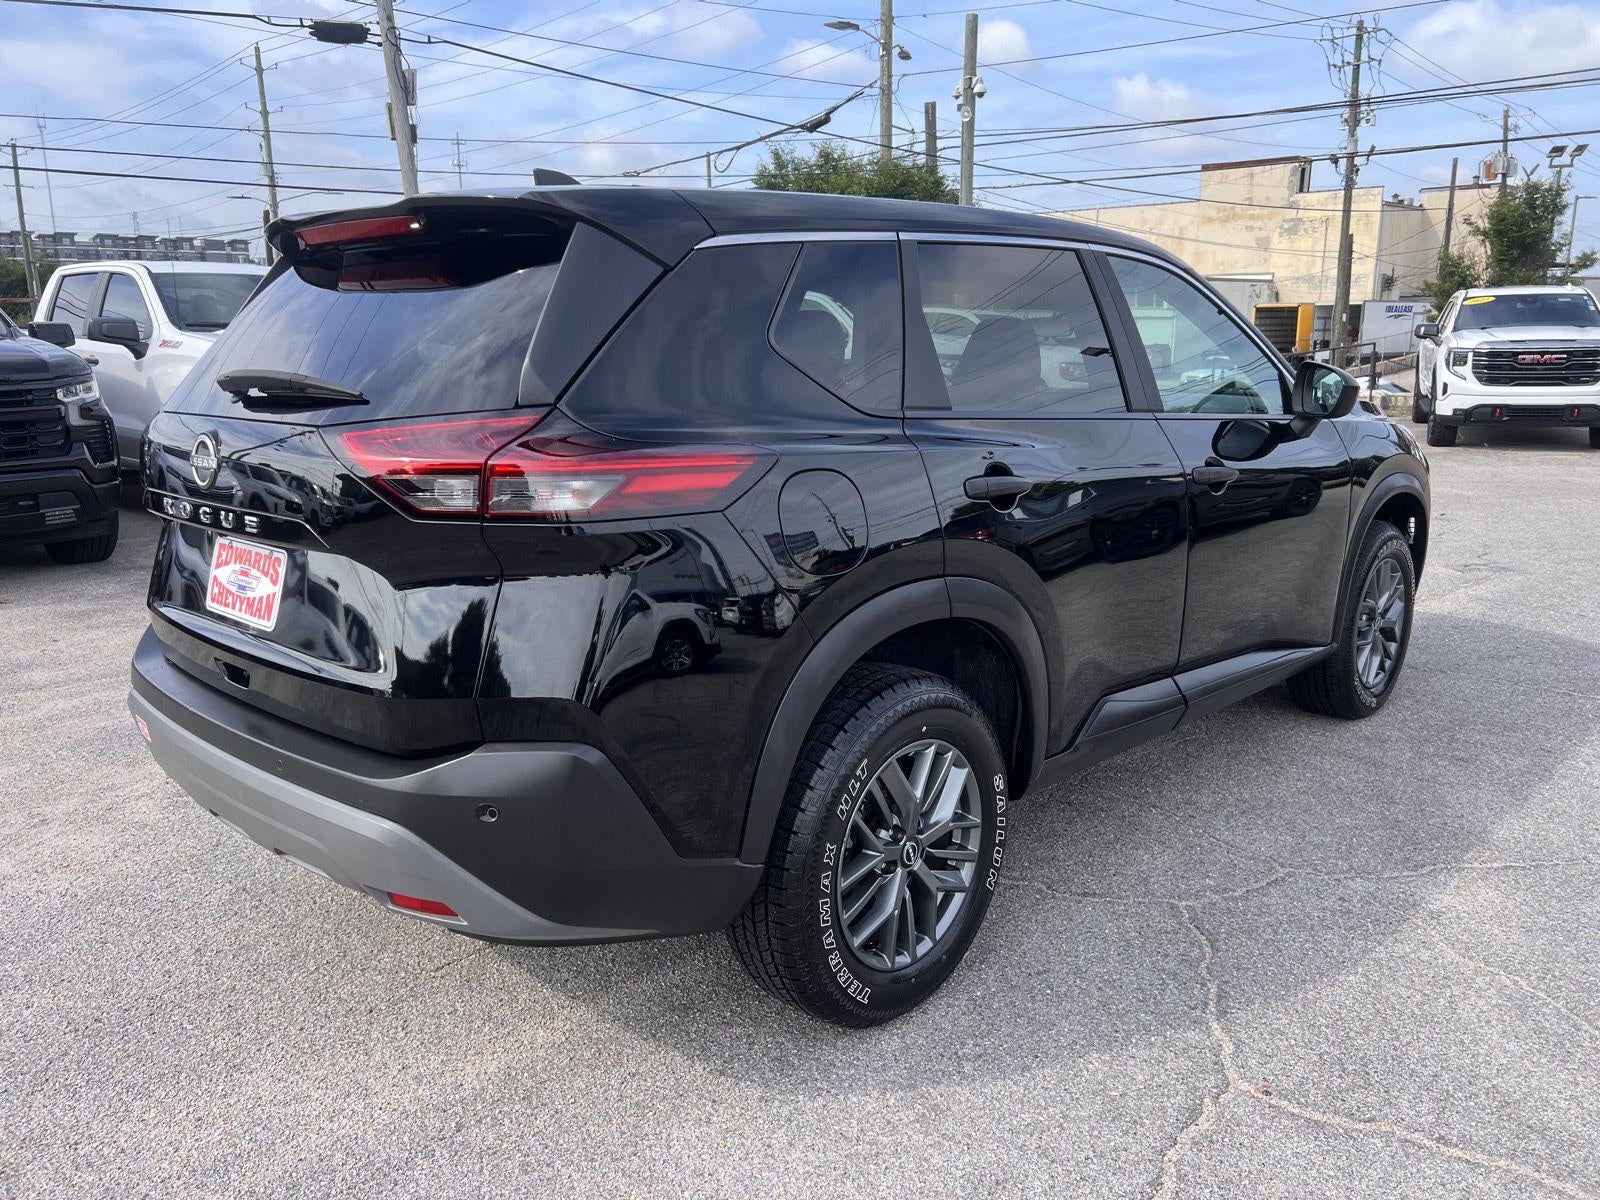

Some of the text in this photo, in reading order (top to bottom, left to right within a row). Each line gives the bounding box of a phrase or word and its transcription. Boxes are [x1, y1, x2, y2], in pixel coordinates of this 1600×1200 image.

[1385, 305, 1413, 313] IDEALEASE
[1518, 354, 1567, 364] GMC
[190, 456, 217, 469] SSAN
[163, 497, 260, 534] ROGUE
[214, 543, 282, 587] EDWARDS
[210, 574, 277, 622] CHEVYMAN
[986, 773, 1006, 891] SAILUN
[819, 758, 871, 1004] TERRAMAX HLT
